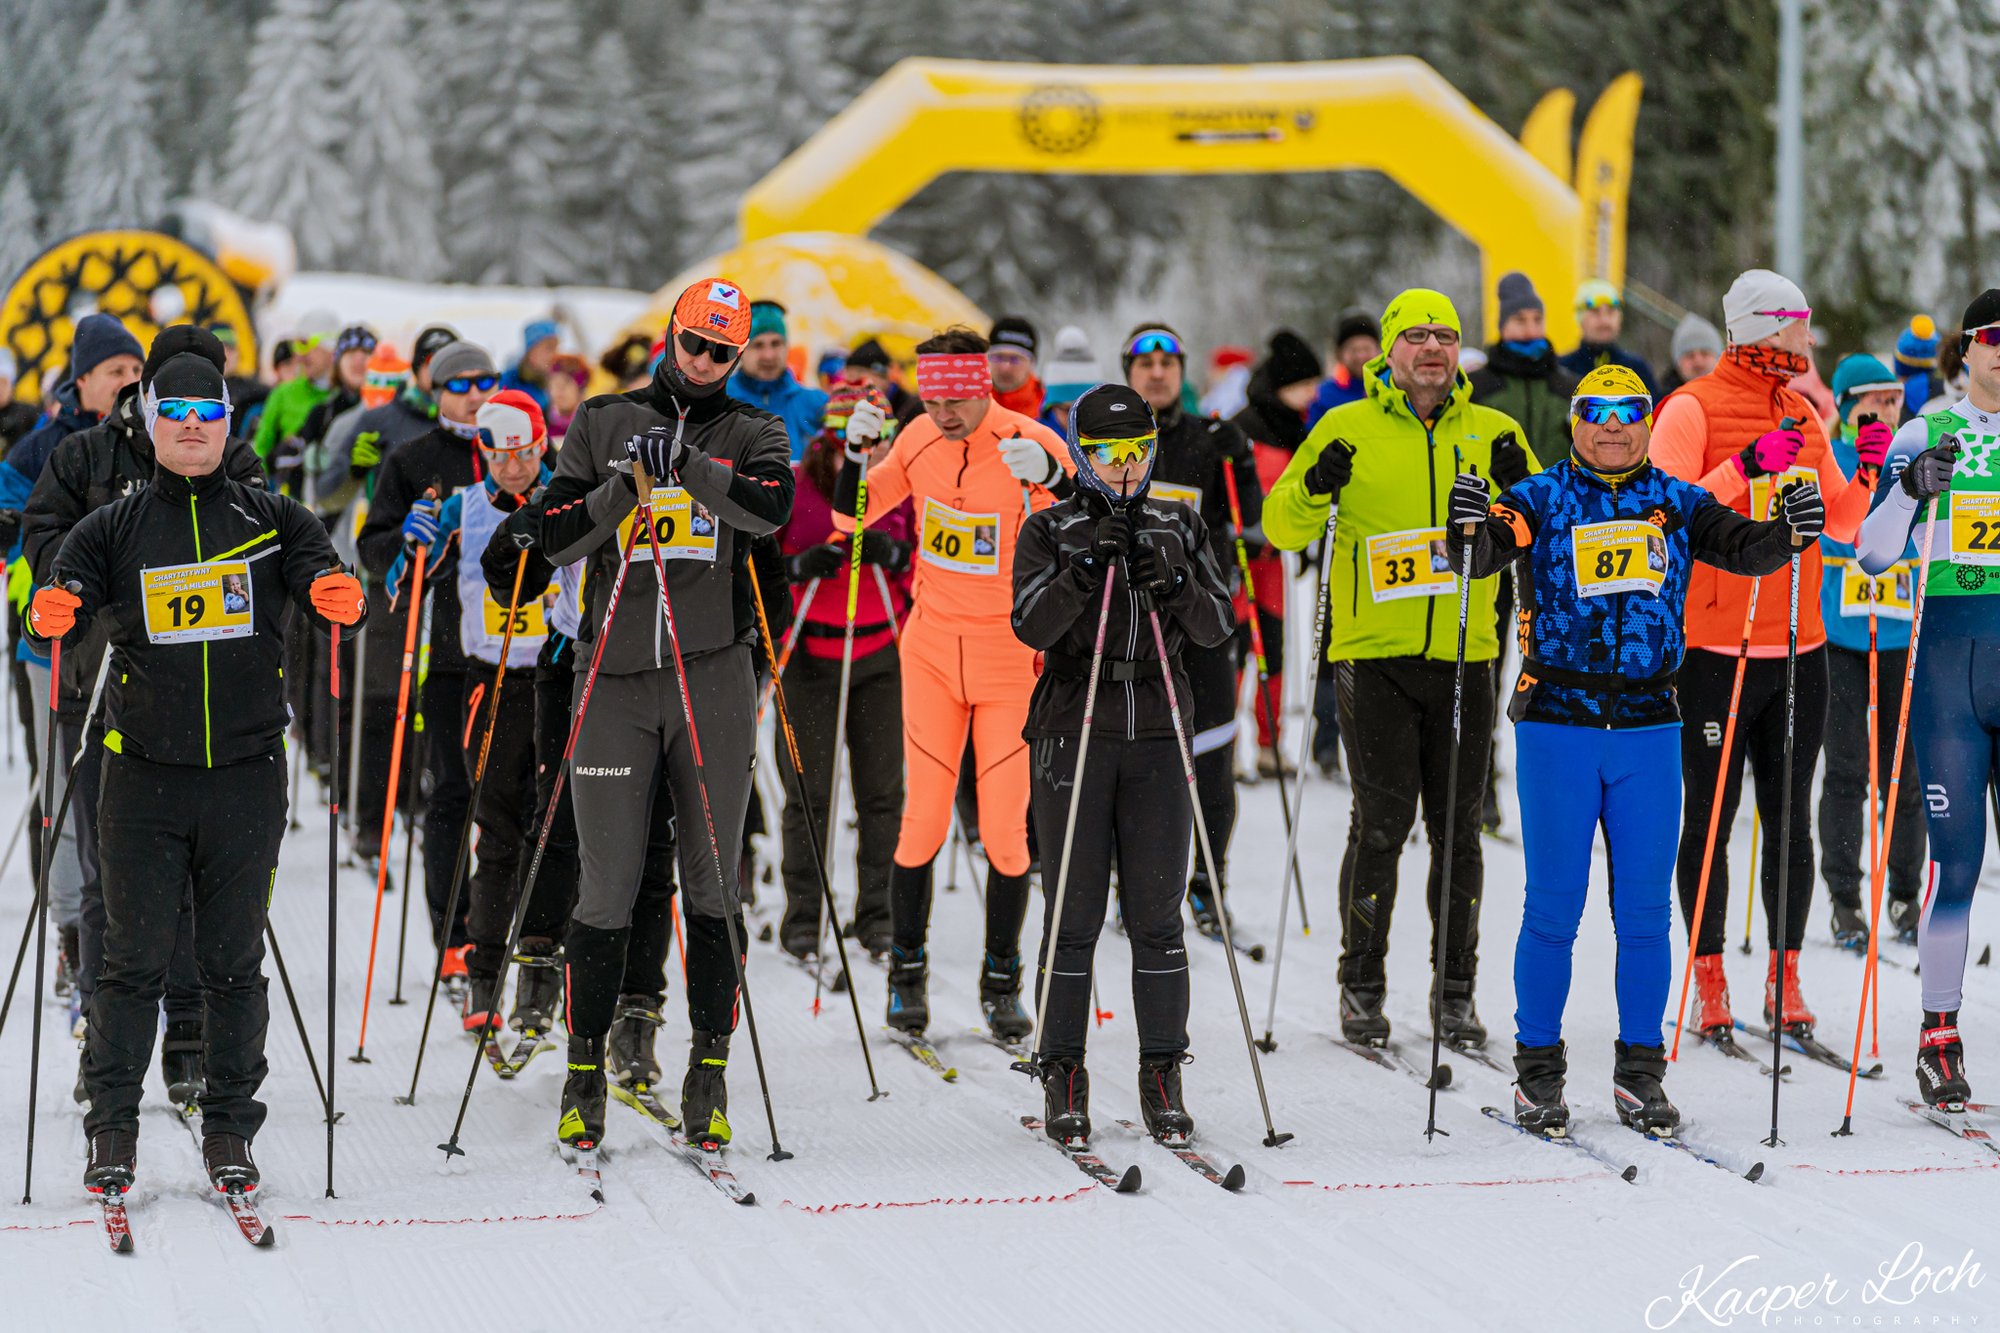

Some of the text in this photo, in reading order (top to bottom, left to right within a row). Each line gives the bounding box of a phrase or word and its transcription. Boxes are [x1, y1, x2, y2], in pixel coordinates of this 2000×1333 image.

[634, 515, 675, 546] 20
[931, 530, 961, 558] 40
[1968, 520, 2000, 550] 22
[153, 567, 212, 582] CHARYTATYWNY
[1385, 557, 1416, 585] 33
[1595, 548, 1633, 579] 87
[173, 579, 219, 593] DLA MILENKI
[1458, 564, 1470, 630] NORDWAY
[166, 594, 206, 627] 19
[1789, 568, 1800, 637] NORDWAY
[498, 610, 529, 634] 25
[575, 766, 632, 777] MADSHUS
